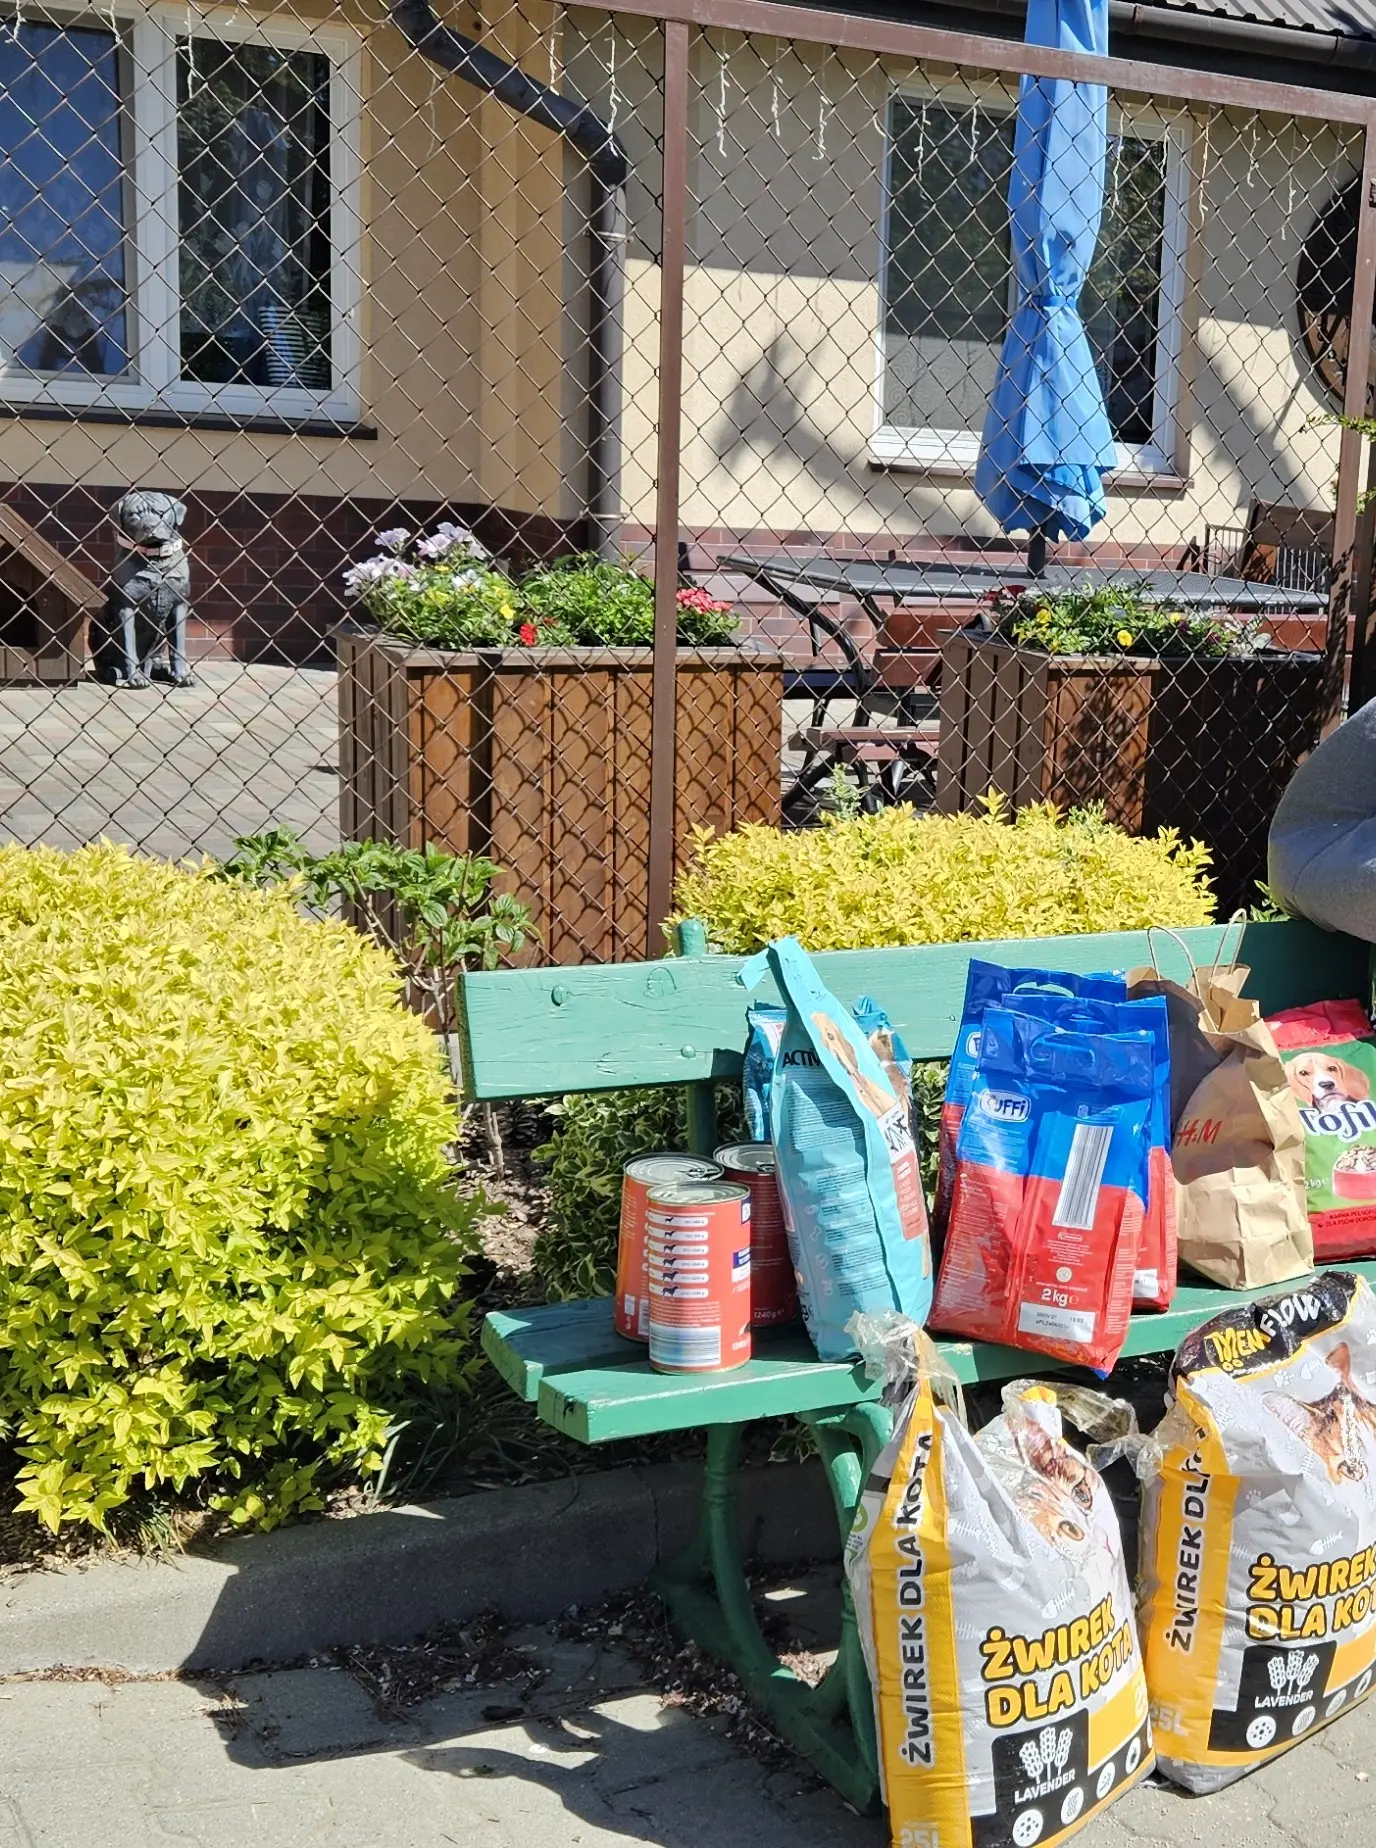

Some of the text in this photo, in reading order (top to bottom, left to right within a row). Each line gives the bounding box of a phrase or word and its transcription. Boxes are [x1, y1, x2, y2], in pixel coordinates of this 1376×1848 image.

[1176, 1118, 1222, 1147] H&M
[898, 1534, 925, 1607] DLA
[1165, 1524, 1202, 1653] ŻWIREK
[979, 1592, 1116, 1683] ŻWIREK
[1245, 1601, 1327, 1642] DLA
[901, 1615, 932, 1766] ŻWIREK
[984, 1669, 1076, 1728] DLA
[1079, 1618, 1135, 1701] KOTA
[1254, 1690, 1314, 1709] LAVENDER
[1014, 1769, 1076, 1805] LAVENDER
